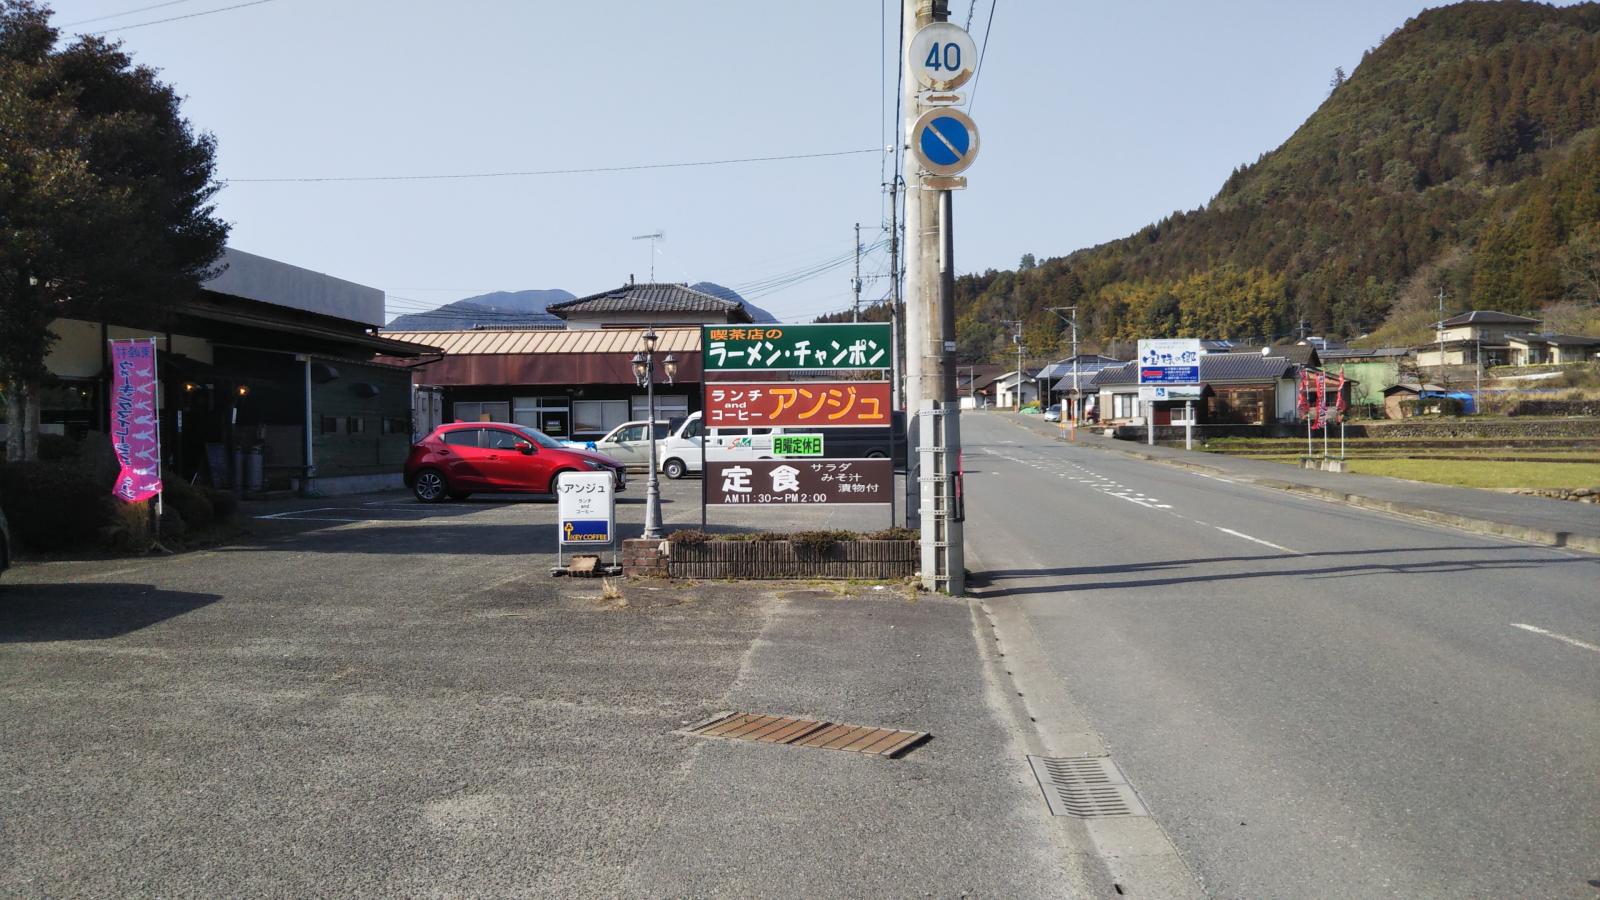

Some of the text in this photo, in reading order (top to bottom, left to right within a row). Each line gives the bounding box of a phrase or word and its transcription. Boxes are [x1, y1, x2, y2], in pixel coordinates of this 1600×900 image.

[925, 42, 961, 71] 40
[710, 329, 783, 340] 喫茶店の
[709, 339, 885, 367] ラーメン・チャンポン
[712, 390, 762, 401] ランチ
[769, 386, 884, 420] アンジュ
[712, 410, 762, 421] コーヒー
[773, 438, 822, 454] 月曜定休日
[811, 463, 852, 472] サラダ
[721, 464, 800, 493] 定食
[821, 473, 862, 482] みそ汁
[564, 483, 606, 493] アンジュ
[838, 483, 880, 493] 漬物付
